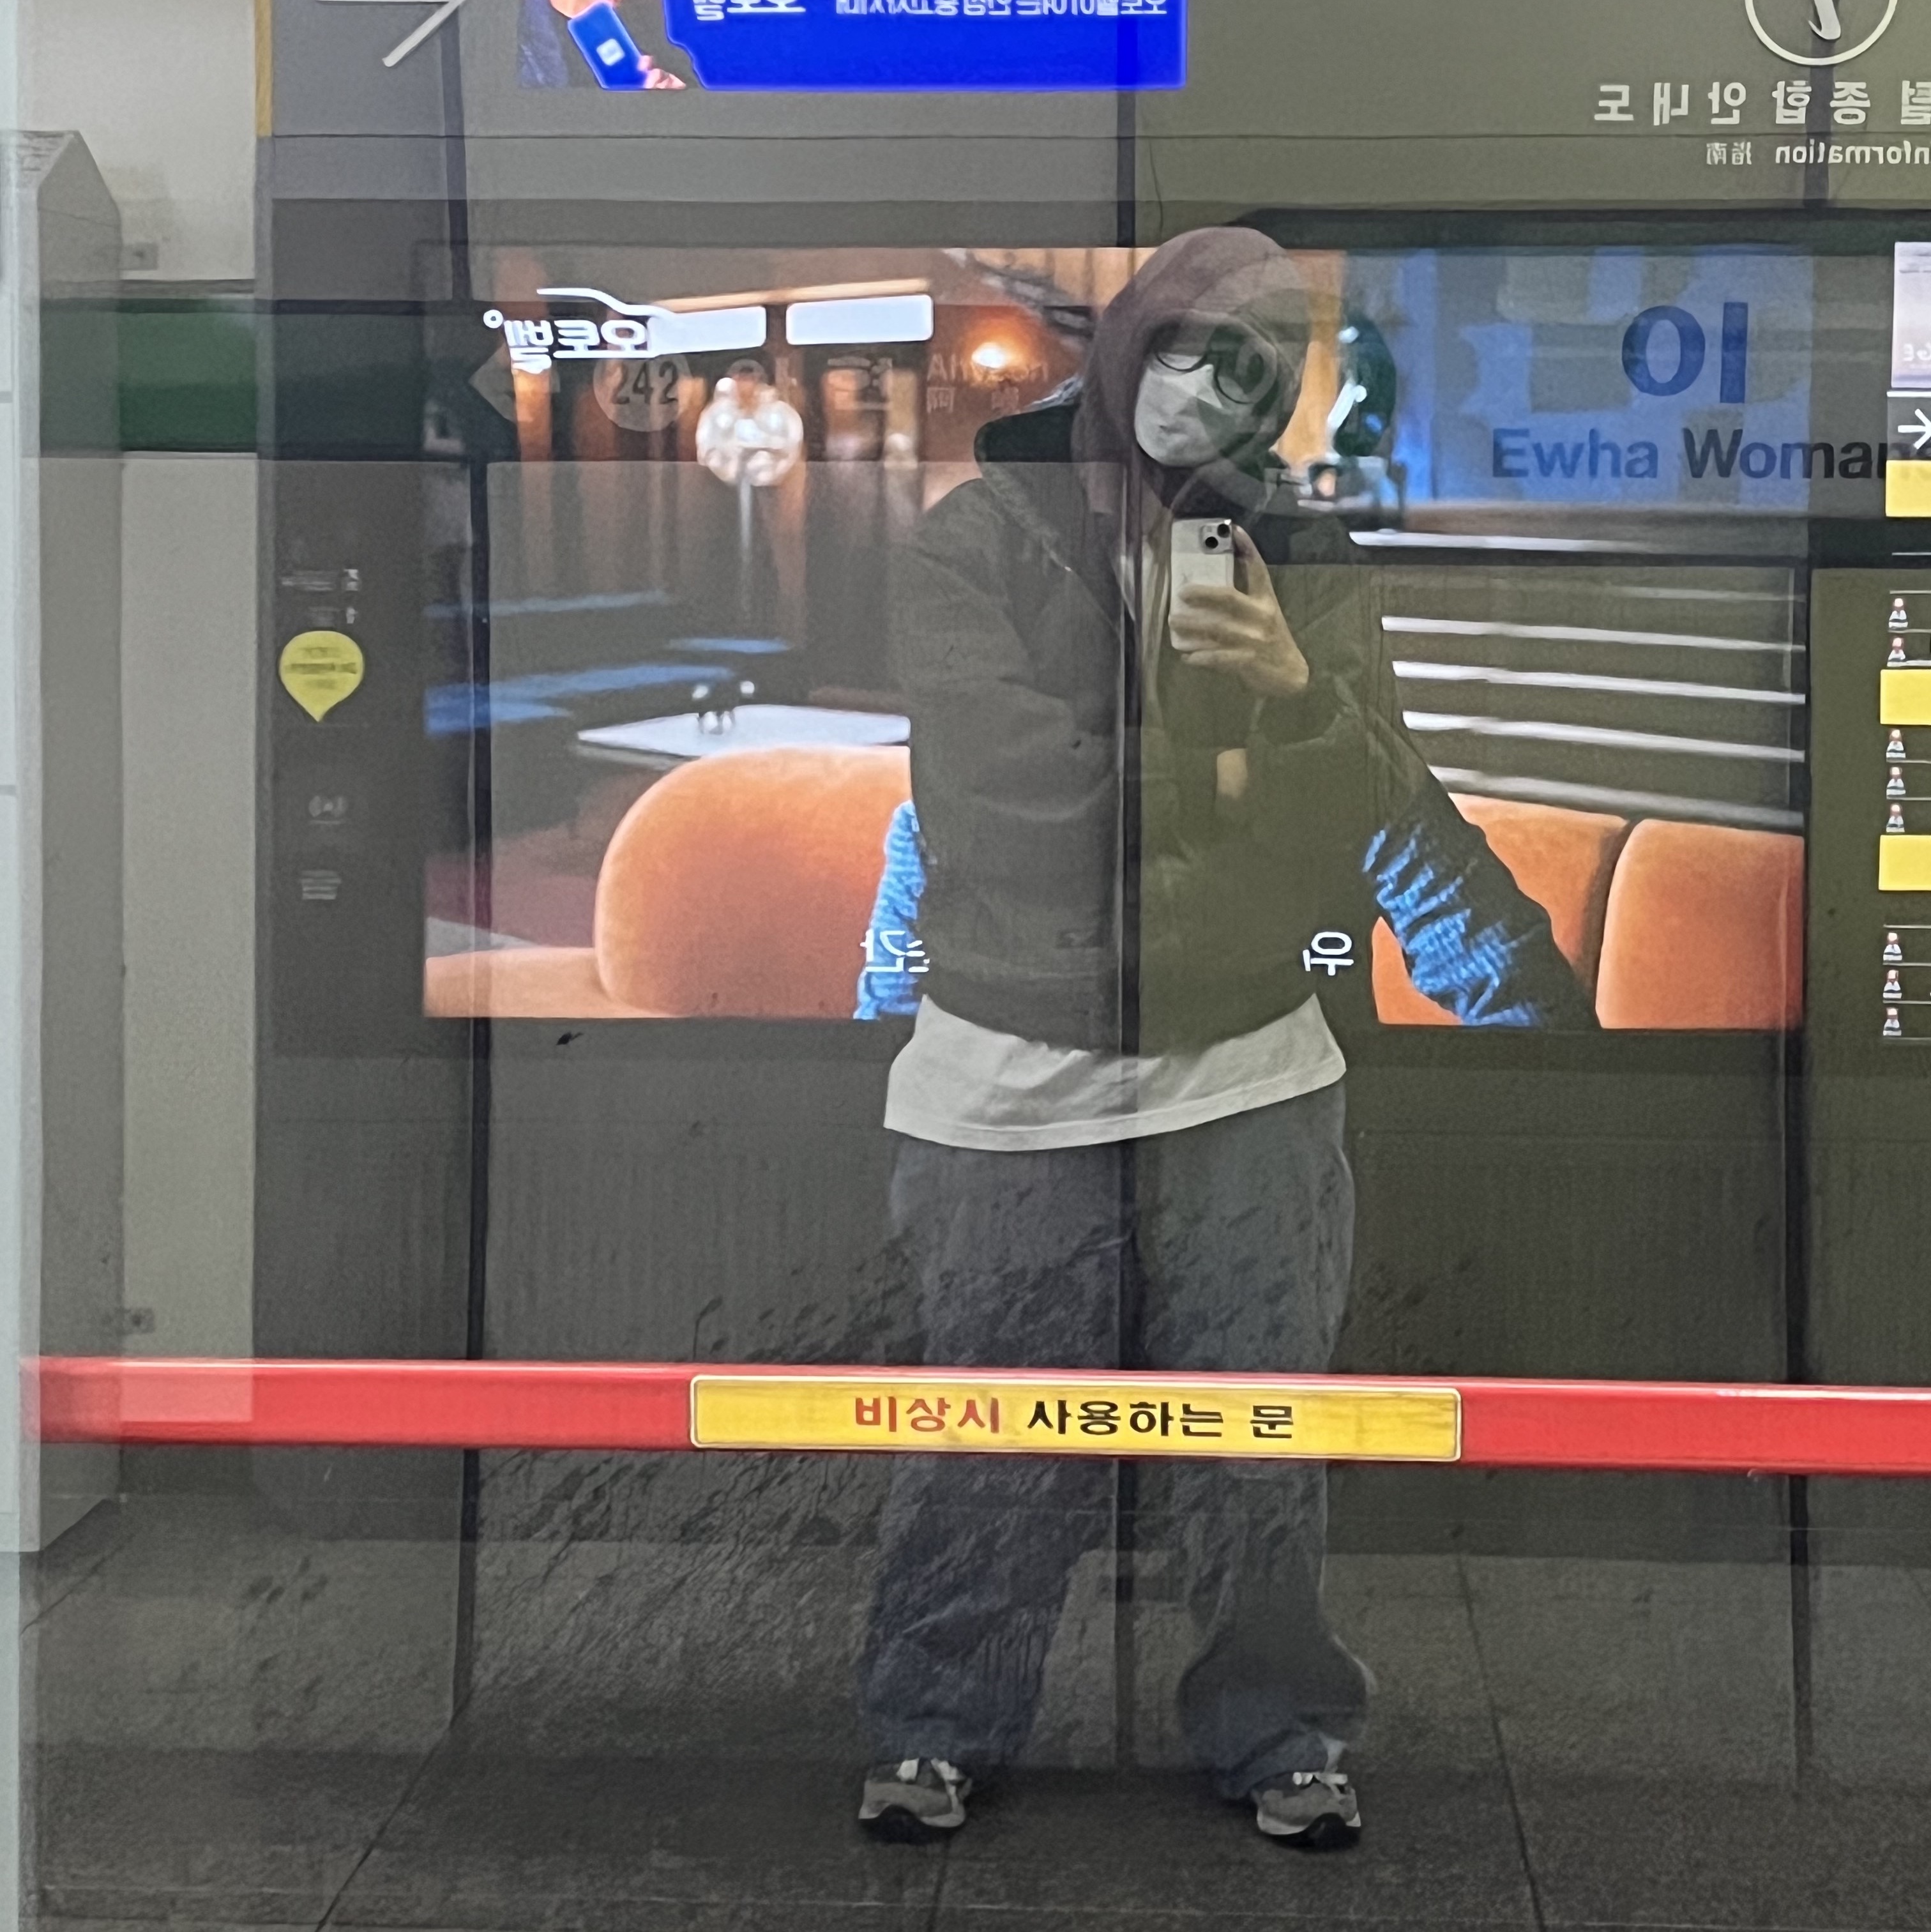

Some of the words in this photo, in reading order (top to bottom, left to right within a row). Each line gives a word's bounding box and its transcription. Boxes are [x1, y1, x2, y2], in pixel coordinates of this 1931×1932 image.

[610, 360, 679, 406] 242
[1492, 427, 1658, 479] Ewha
[1683, 427, 1931, 480] Woman
[855, 1396, 999, 1434] 비상시
[1027, 1399, 1223, 1438] 사용하는
[1249, 1405, 1294, 1439] 문
